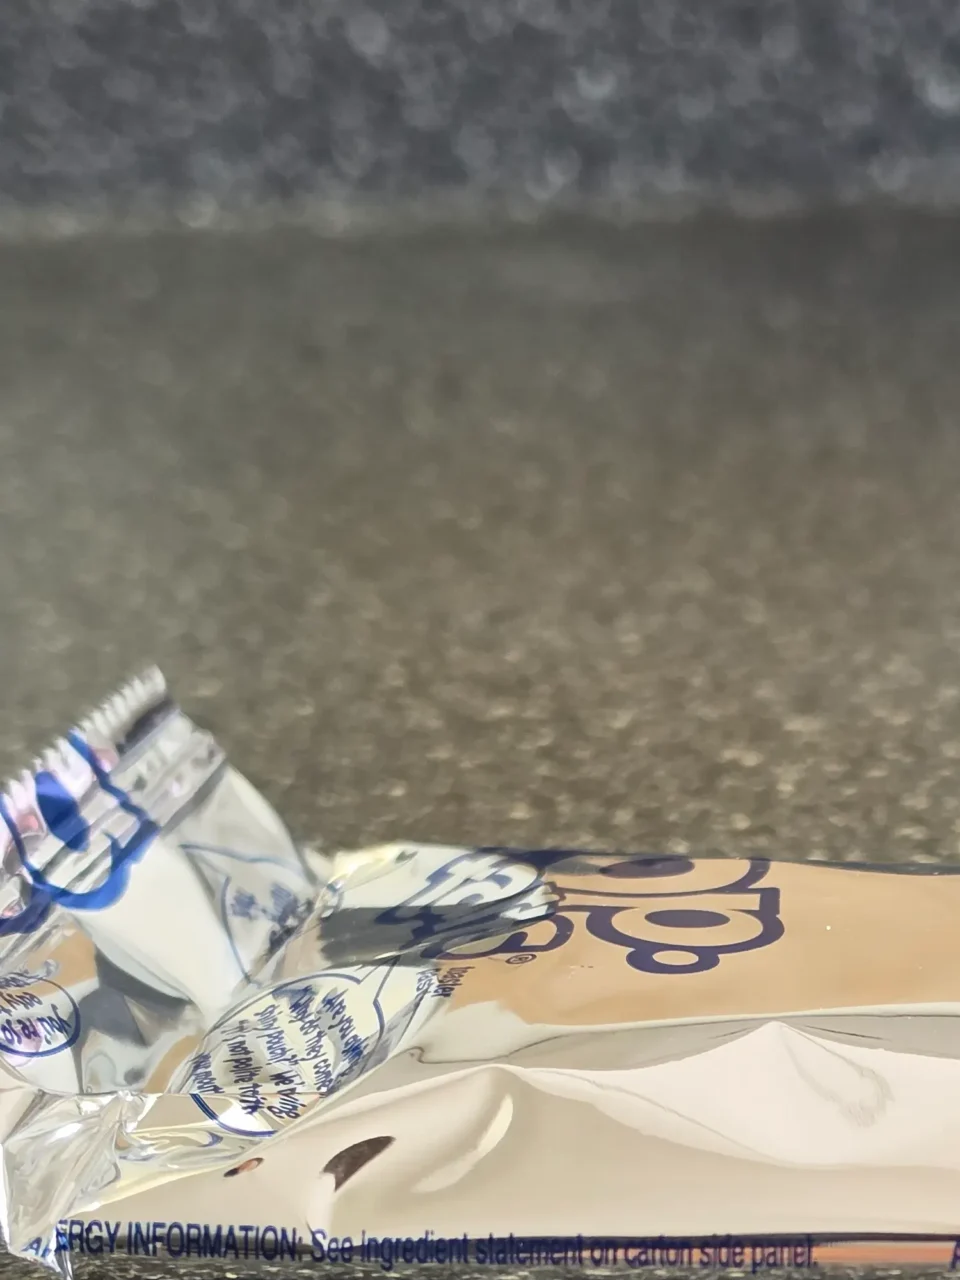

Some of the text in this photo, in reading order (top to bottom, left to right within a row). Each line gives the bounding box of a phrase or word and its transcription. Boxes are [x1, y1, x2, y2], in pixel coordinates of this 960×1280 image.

[228, 1041, 255, 1056] not
[222, 1057, 263, 1084] polite
[310, 1228, 354, 1262] See
[361, 1229, 469, 1271] ingredient
[475, 1231, 583, 1265] statement
[590, 1237, 618, 1266] on
[624, 1234, 693, 1268] carton
[700, 1233, 745, 1267] side
